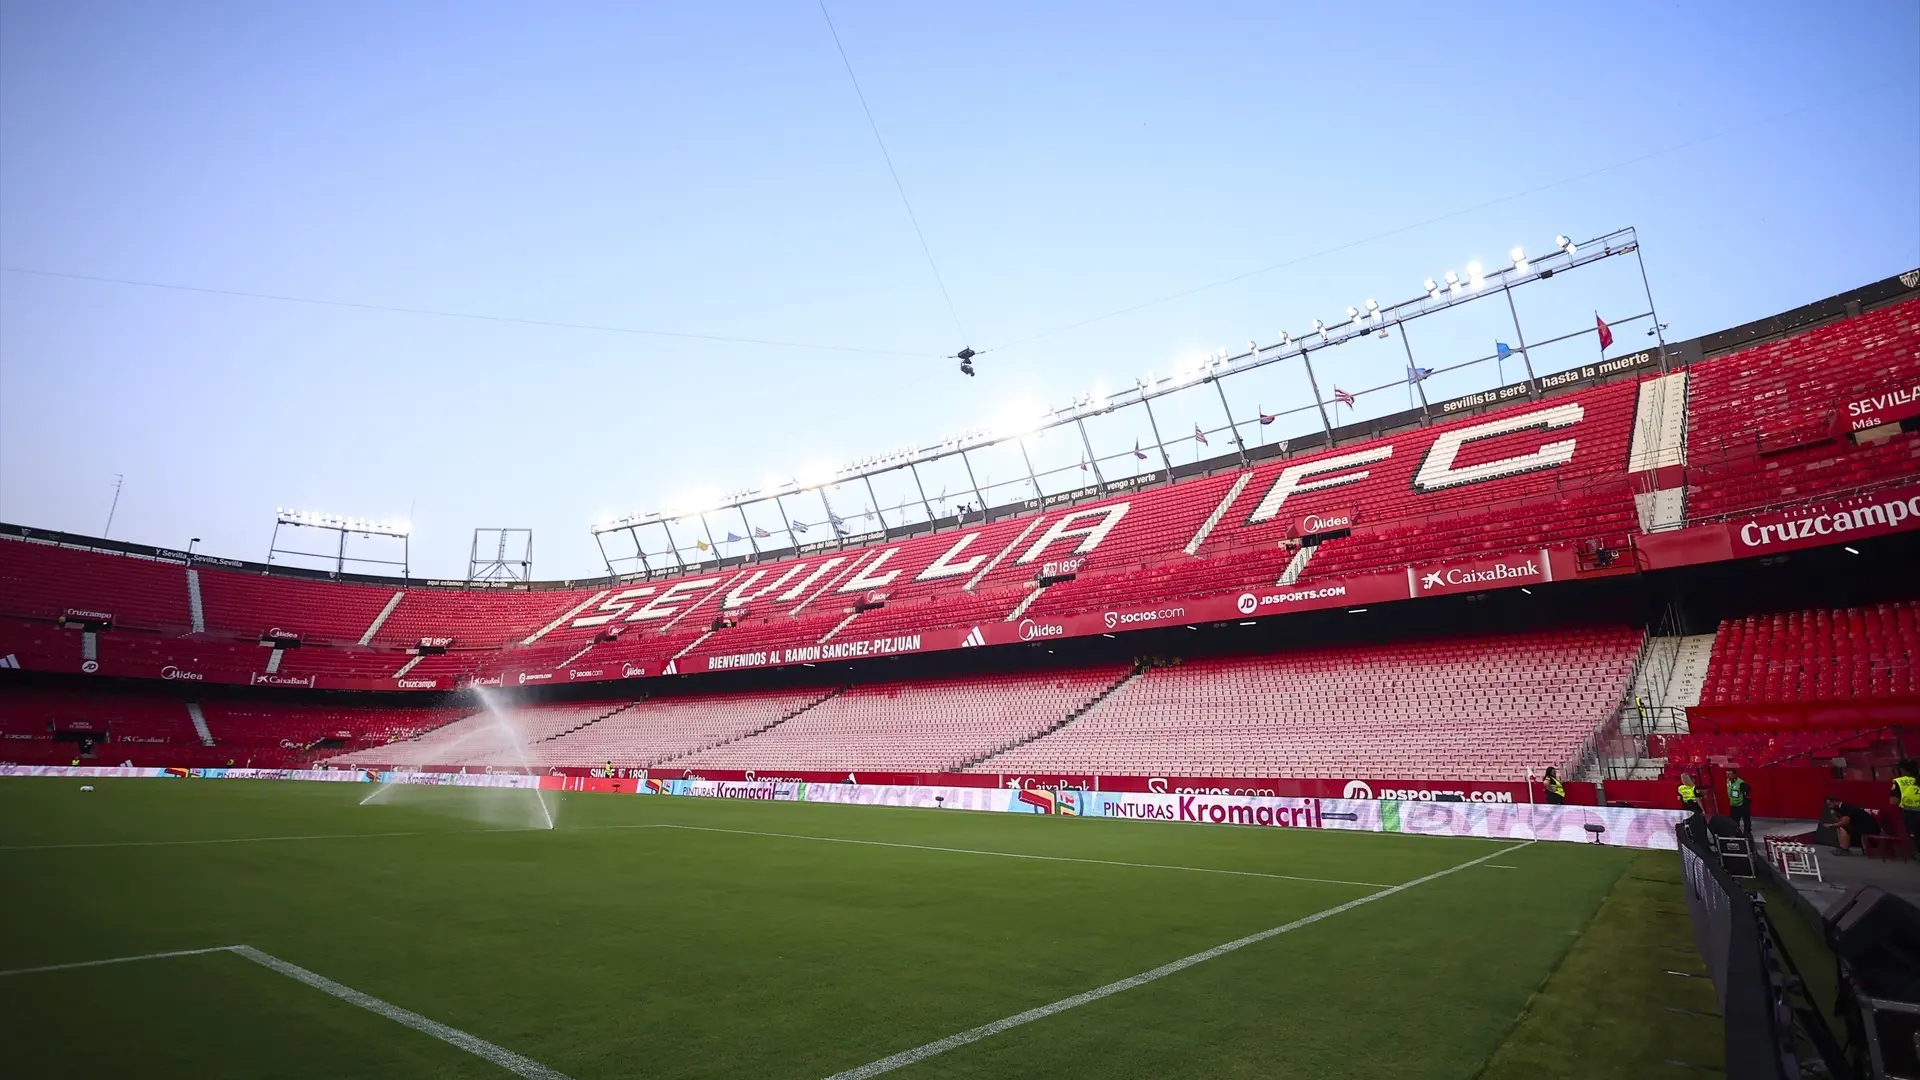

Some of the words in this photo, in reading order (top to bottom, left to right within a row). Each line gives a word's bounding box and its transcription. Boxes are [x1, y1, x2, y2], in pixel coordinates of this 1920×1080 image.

[1444, 390, 1496, 412] sevillista
[1500, 384, 1526, 400] seré
[1542, 372, 1578, 388] hasta
[1582, 367, 1595, 379] la
[1600, 352, 1650, 374] muerte
[1848, 384, 1920, 416] SEVILLA
[1852, 416, 1881, 430] Más
[1045, 496, 1056, 506] por
[1058, 494, 1070, 502] eso
[1071, 491, 1084, 500] que
[1085, 486, 1097, 496] hoy
[1106, 480, 1128, 490] vengo
[1137, 473, 1156, 484] verte
[570, 502, 1132, 628] SEVILLA
[1249, 402, 1585, 524] FC
[1304, 515, 1348, 533] Midea
[1740, 496, 1920, 547] Cruzcampo
[1446, 560, 1539, 585] CaixaBank
[1260, 586, 1346, 605] JDSPORTS.COM
[68, 608, 112, 619] Cruzcampo
[270, 628, 298, 638] Midea
[1020, 620, 1062, 640] Midea
[709, 652, 766, 669] BIENVENIDOS
[769, 650, 781, 664] AL
[785, 646, 820, 662] RAMON
[822, 634, 920, 659] SANCHEZ-PIZJUAN
[162, 666, 203, 680] Midea
[269, 676, 308, 685] CaixaBank
[398, 680, 436, 688] Cruzcampo
[683, 786, 715, 798] PINTURAS
[716, 782, 776, 800] Kromacril
[1377, 789, 1512, 803] JDSPORS.COM
[1104, 802, 1174, 820] PINTURAS
[1179, 796, 1322, 828] Kromacril
